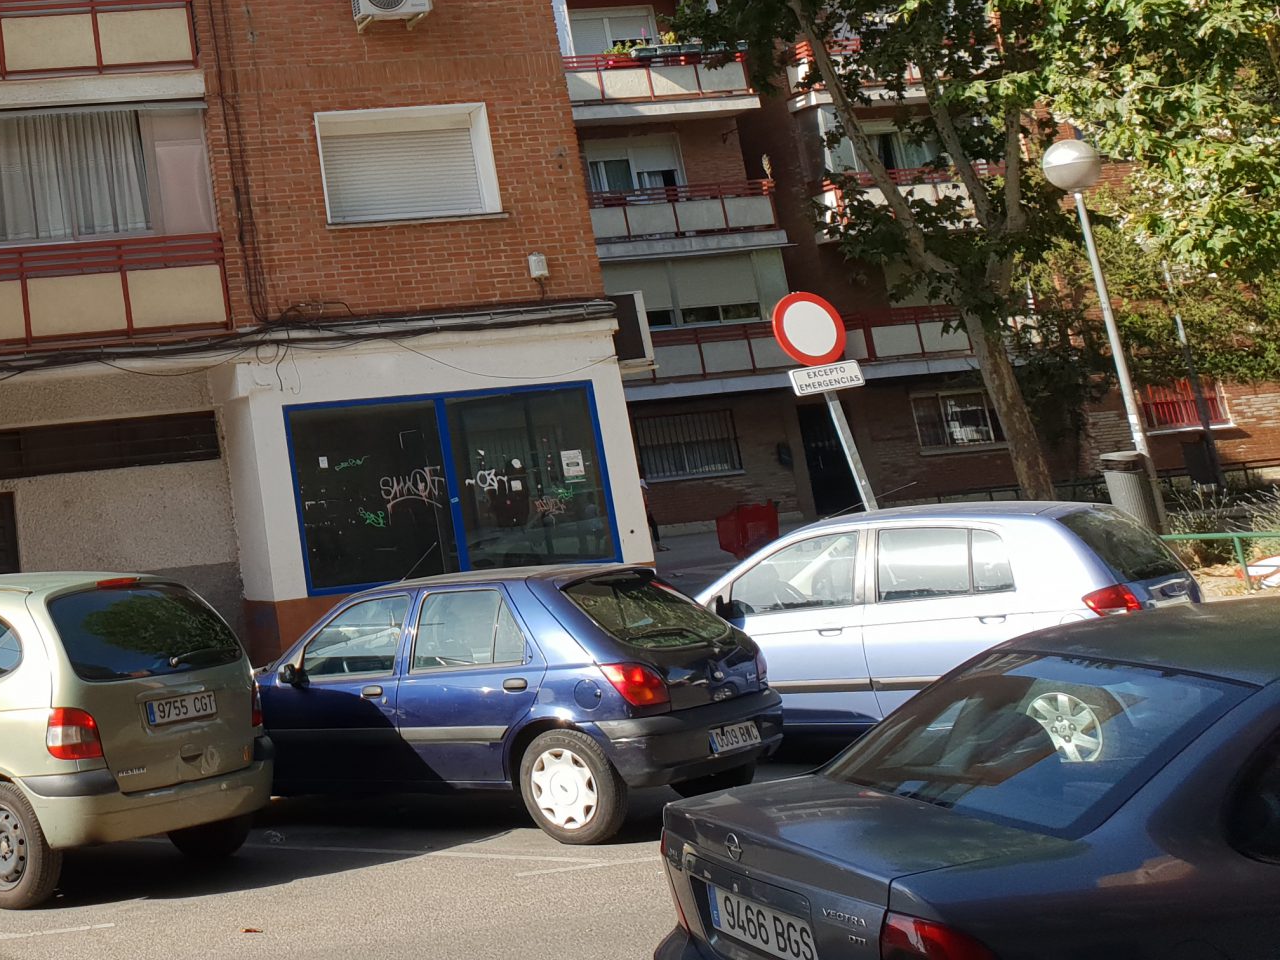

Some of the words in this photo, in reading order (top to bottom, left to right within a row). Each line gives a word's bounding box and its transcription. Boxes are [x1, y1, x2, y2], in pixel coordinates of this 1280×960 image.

[800, 375, 860, 391] EMERGENCIAS
[807, 367, 846, 379] EXCEPTO
[158, 699, 188, 719] 9755
[193, 694, 213, 713] CGT
[724, 895, 770, 945] 9466
[773, 914, 814, 960] BGS
[822, 907, 868, 928] VECTRA
